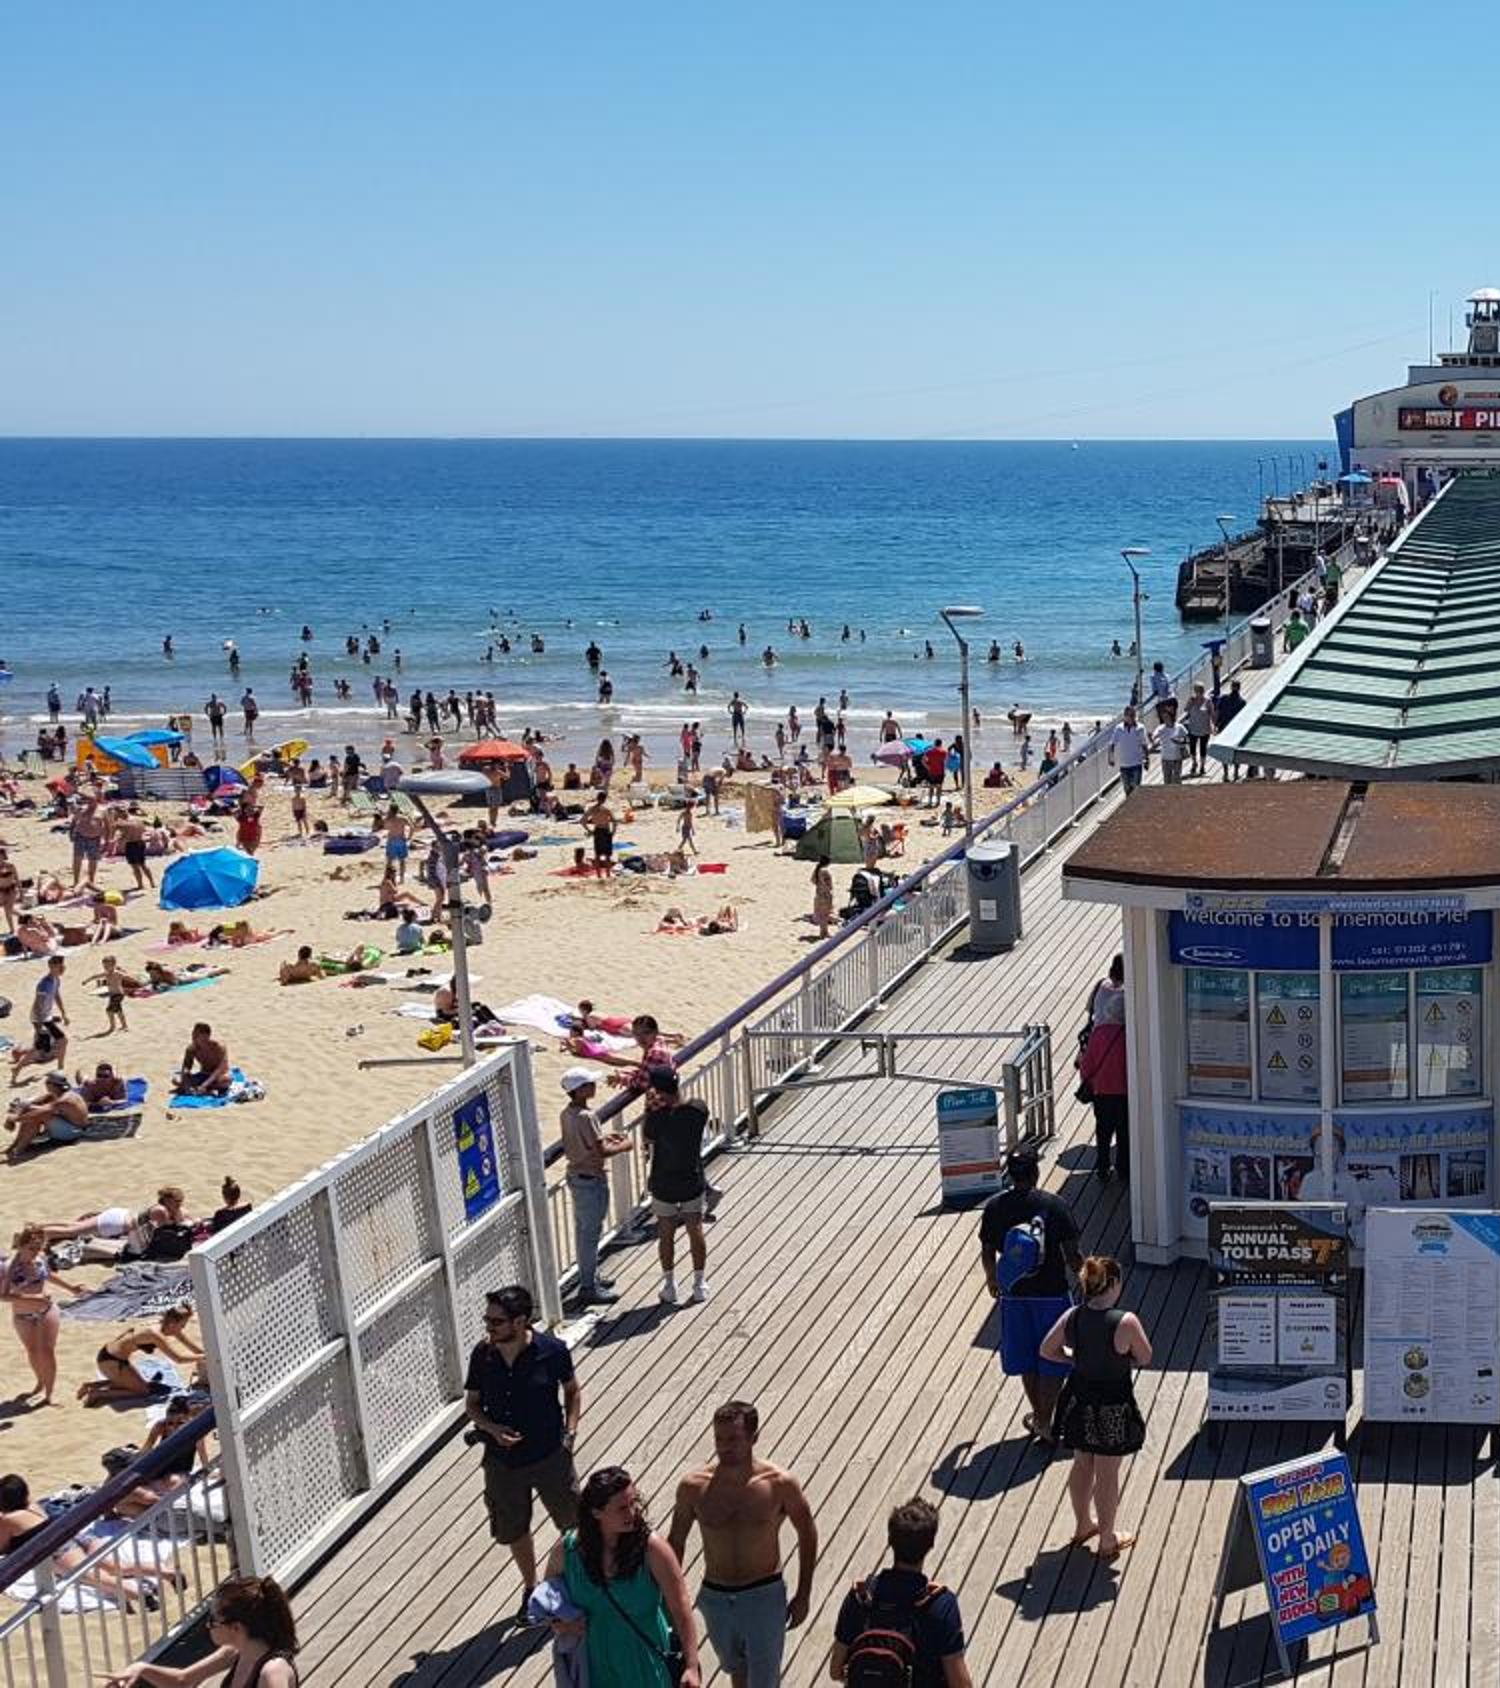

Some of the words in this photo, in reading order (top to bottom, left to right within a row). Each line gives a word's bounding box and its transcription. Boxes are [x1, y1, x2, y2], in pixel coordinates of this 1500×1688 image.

[1183, 908, 1265, 927] Welcome
[1271, 912, 1291, 927] to
[1435, 908, 1469, 924] Pier
[1221, 1233, 1289, 1245] ANNUAL
[1221, 1246, 1264, 1259] TOLL
[1267, 1247, 1313, 1260] PASS
[1267, 1514, 1316, 1553] OPEN
[1301, 1521, 1350, 1560] DAILY
[1271, 1563, 1307, 1586] WITH
[1279, 1580, 1308, 1606] NEW
[1279, 1600, 1317, 1625] RIDES
